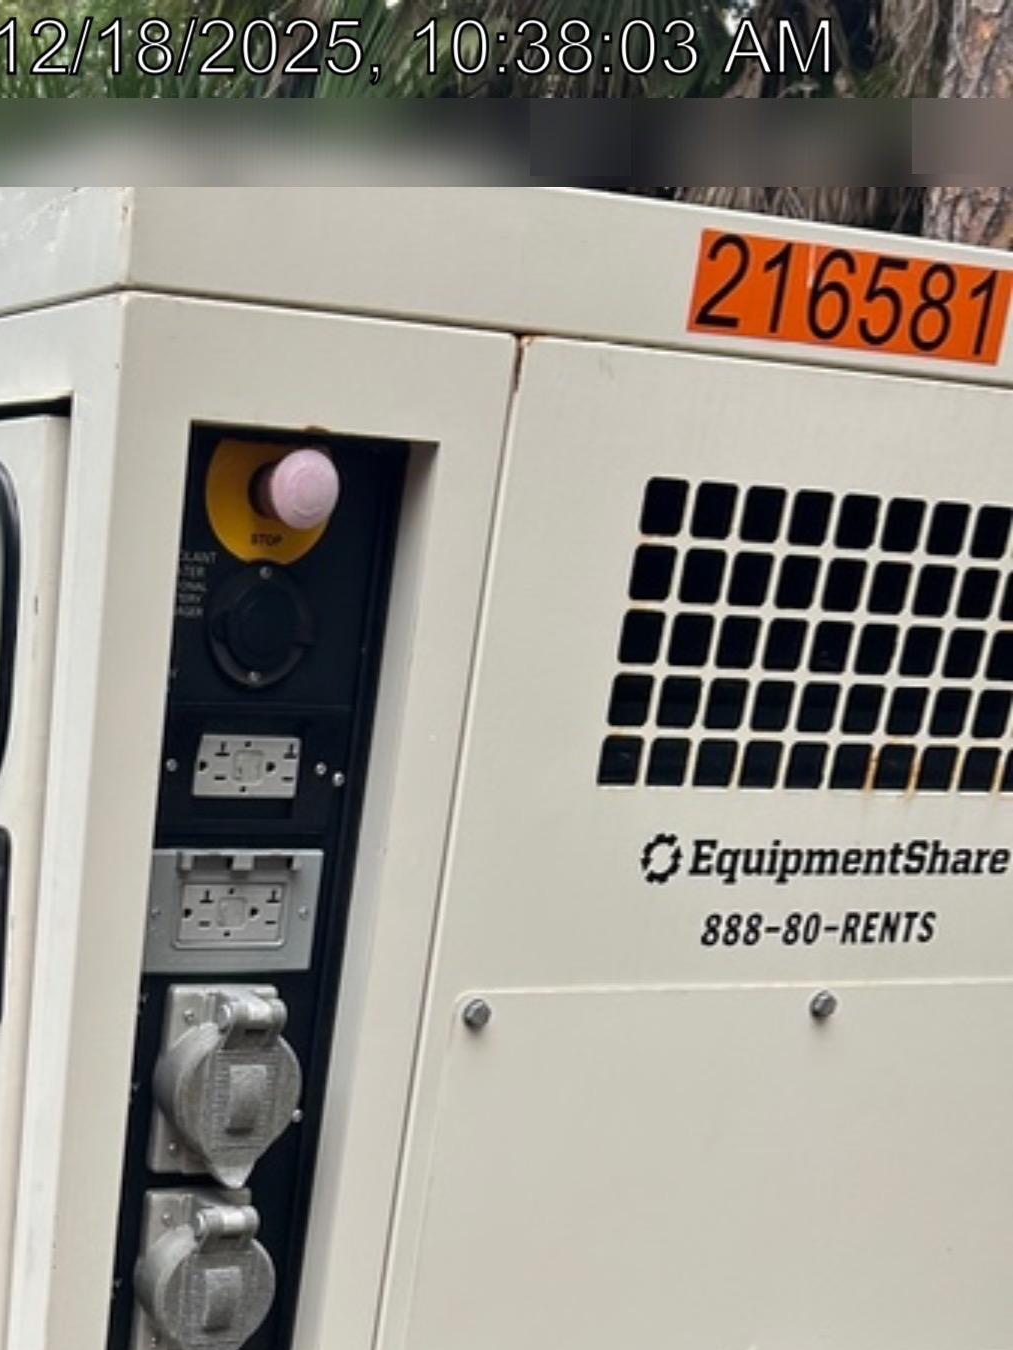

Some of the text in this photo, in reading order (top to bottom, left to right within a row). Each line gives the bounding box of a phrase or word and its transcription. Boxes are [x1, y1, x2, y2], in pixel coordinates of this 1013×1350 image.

[696, 233, 999, 355] 216581
[251, 533, 283, 546] STOP
[688, 838, 1010, 884] EquipmentShare
[700, 911, 938, 946] 888-80-RENTS
